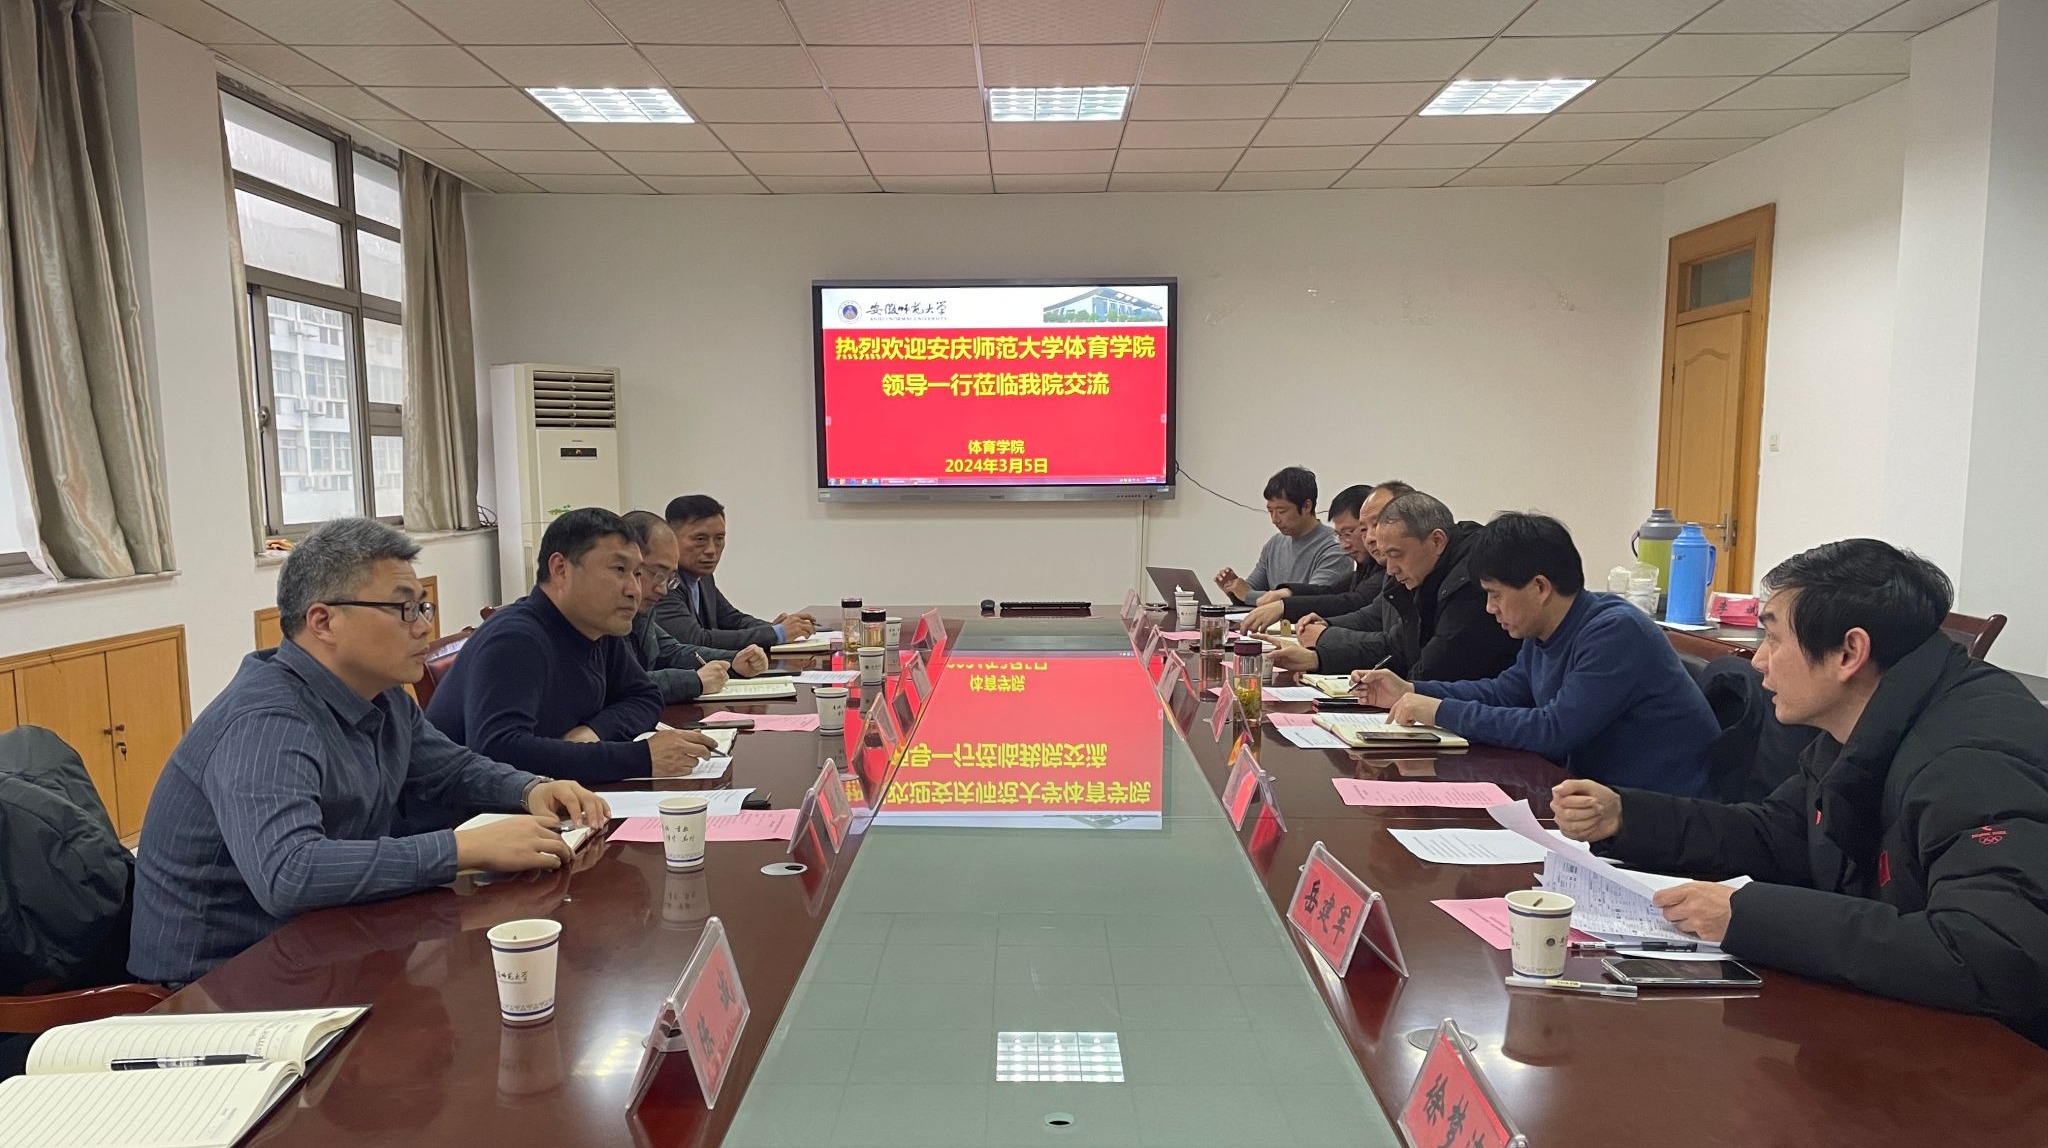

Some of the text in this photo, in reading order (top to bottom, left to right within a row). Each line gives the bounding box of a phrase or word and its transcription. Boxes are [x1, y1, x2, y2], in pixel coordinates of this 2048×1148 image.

[866, 301, 947, 315] 安徽师范大学
[835, 335, 1156, 360] 热烈欢迎安庆师范大学体育学院
[881, 371, 1110, 397] 领导一行莅临我院交流
[968, 440, 1025, 454] 体育学院
[945, 458, 1048, 474] 2024年3月5日
